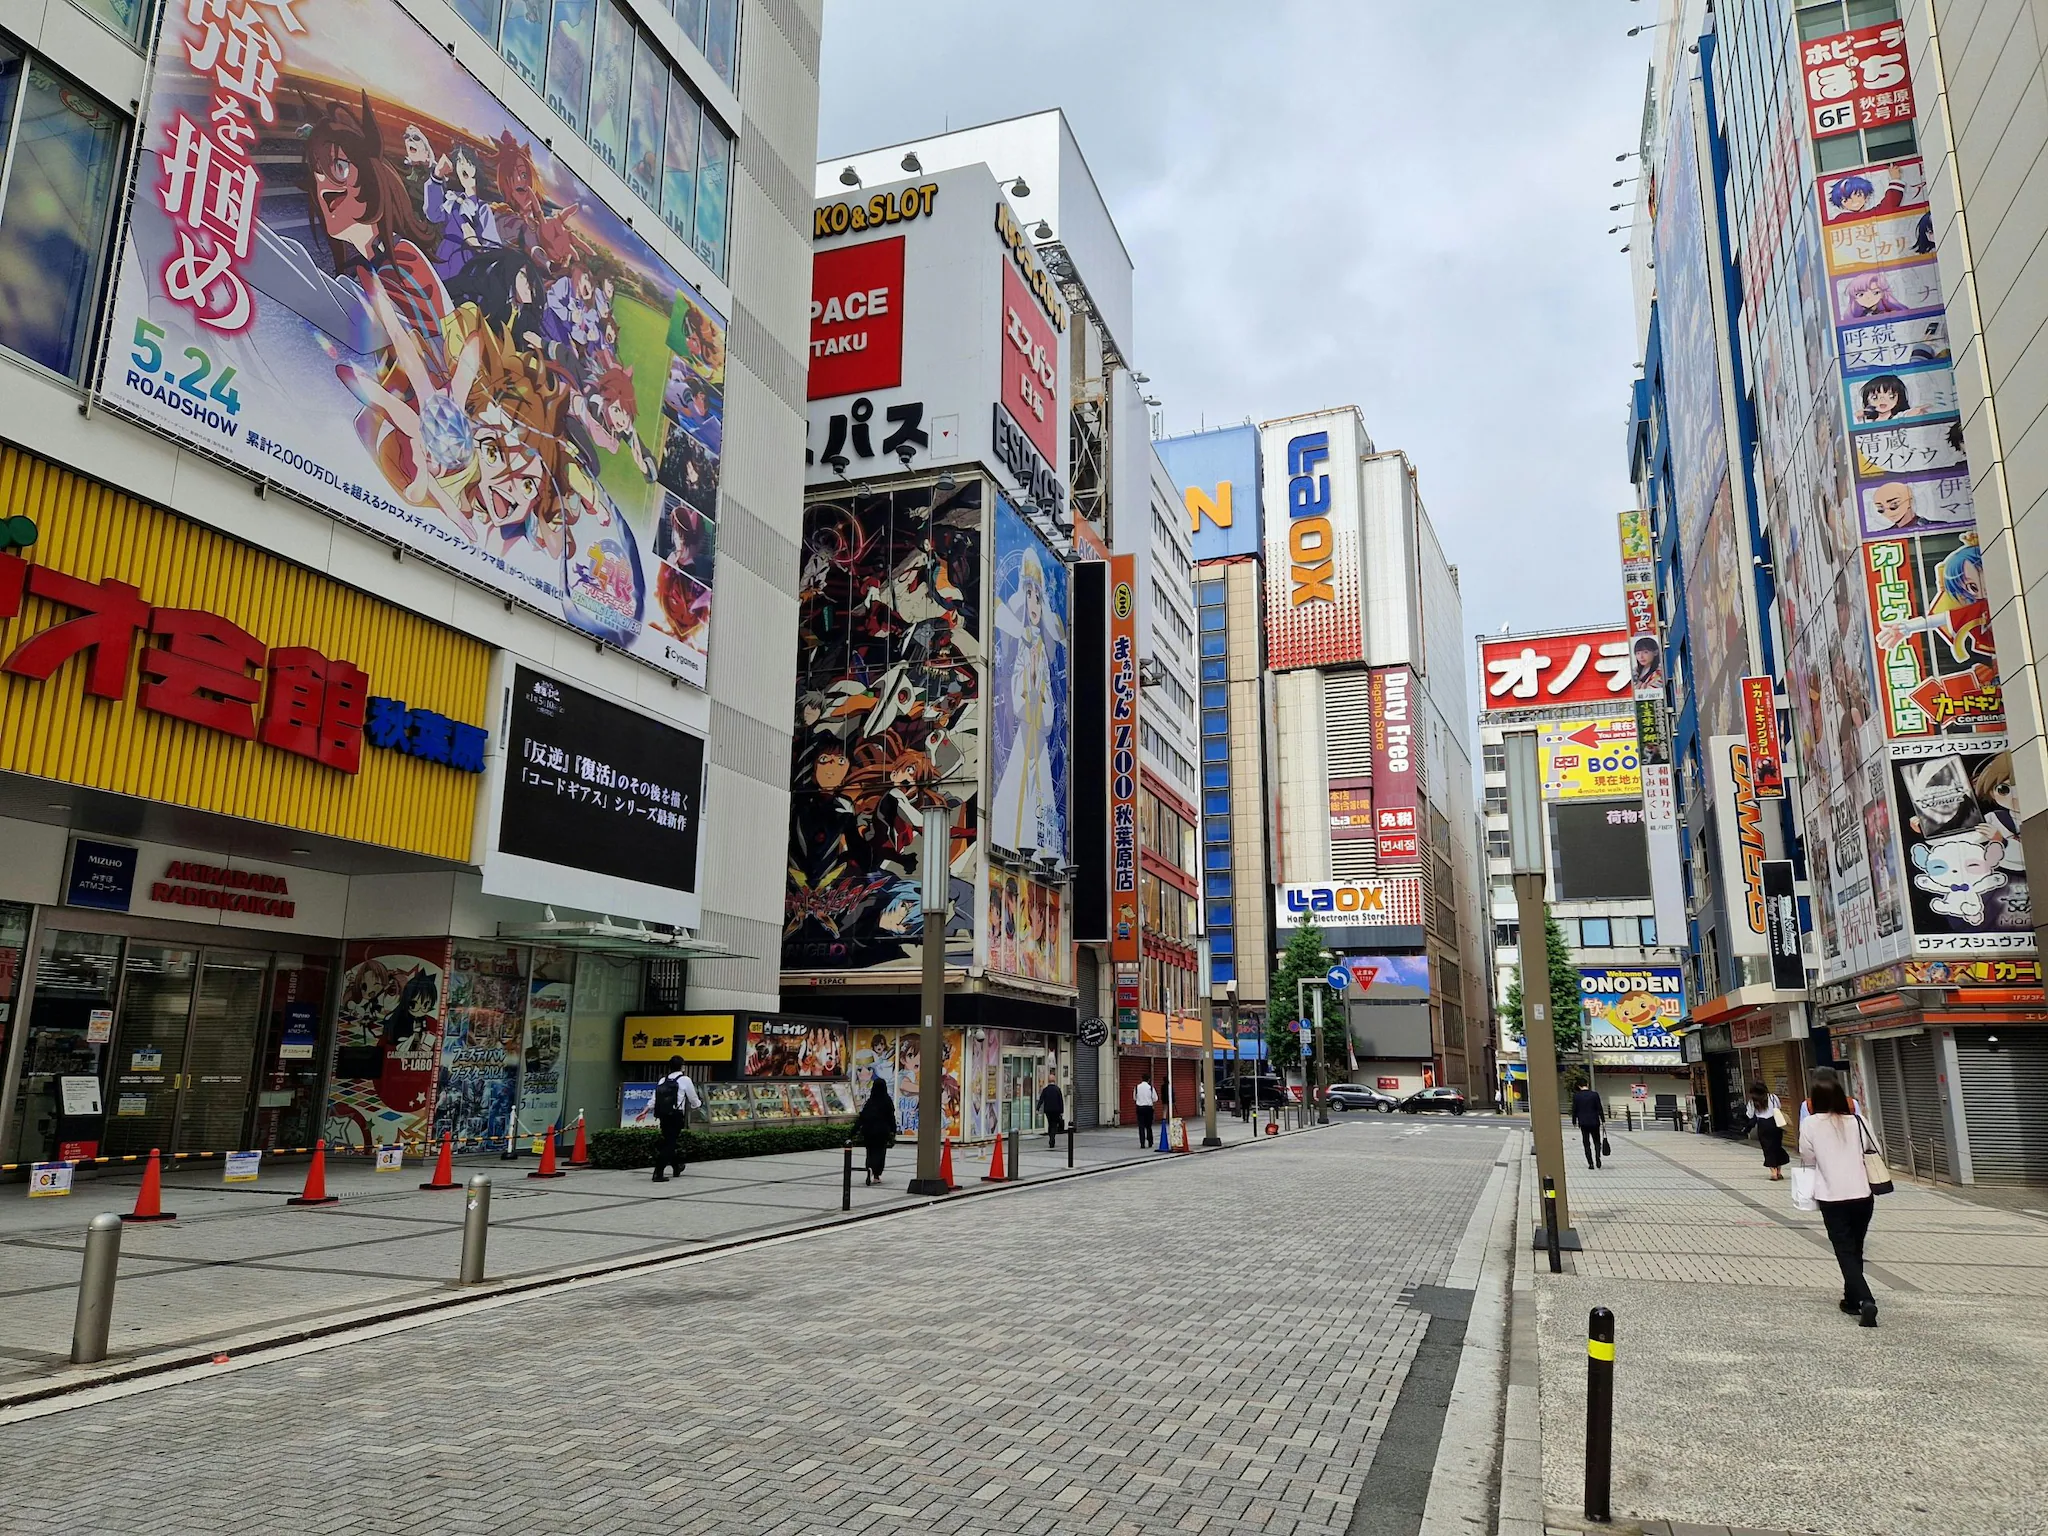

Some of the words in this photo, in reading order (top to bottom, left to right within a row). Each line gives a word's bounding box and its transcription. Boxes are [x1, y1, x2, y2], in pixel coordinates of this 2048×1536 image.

[1808, 53, 1906, 101] ぽち
[1859, 89, 1910, 112] 秋葉原
[1819, 105, 1852, 129] 6F
[1861, 103, 1911, 124] 2号店
[160, 0, 307, 331] 強を掴め
[1831, 225, 1877, 249] 明導
[1857, 237, 1910, 260] ヒカリ
[1845, 322, 1896, 348] 呼続
[1007, 306, 1056, 401] エスパス
[1850, 343, 1908, 366] スオウ
[131, 316, 241, 417] 5.24
[125, 369, 238, 437] ROADSHOW
[805, 396, 929, 463] パス
[1859, 430, 1910, 456] 清蔵
[992, 401, 1067, 527] ESPACE
[1864, 448, 1938, 472] タイゾウ
[1626, 572, 1651, 584] 麻雀
[1116, 584, 1131, 618] ZOO
[1872, 543, 1925, 733] カードゲム専門店
[670, 649, 699, 671] Cygames
[1372, 674, 1384, 717] Flagship
[1384, 671, 1409, 721] Duty
[1932, 692, 2006, 722] カードキン
[1752, 689, 1769, 756] カードキングダム
[367, 696, 490, 774] 秋葉原
[1374, 720, 1385, 751] Store
[1386, 724, 1412, 773] Free
[1892, 744, 1909, 755] 2F
[1555, 757, 1578, 767] ここ!
[1587, 755, 1639, 773] BOO
[1380, 809, 1413, 828] 免税
[1113, 804, 1135, 892] 秋葉原店
[1380, 839, 1416, 853] 면세점
[1729, 743, 1768, 935] GAMERS
[88, 854, 123, 868] MIZUHO
[78, 880, 124, 894] ATMコーナー
[164, 860, 289, 896] AKIHABARA
[150, 882, 297, 920] RADIOKAIKAN
[1287, 914, 1311, 924] Hom
[1314, 913, 1360, 923] Electronics
[1361, 912, 1386, 922] Store
[1580, 977, 1680, 993] ONODEN
[1606, 970, 1641, 978] Welcome
[1642, 970, 1652, 978] to
[1584, 998, 1604, 1019] 歓
[1660, 998, 1681, 1018] 迎
[652, 1034, 725, 1047] 銀座ライオン
[772, 1023, 808, 1035] 銀座ライオン
[1583, 1035, 1681, 1048] AKIHABARA
[401, 1059, 433, 1071] C-LABO
[418, 1051, 434, 1059] SHOP
[1644, 1054, 1680, 1066] オノデン
